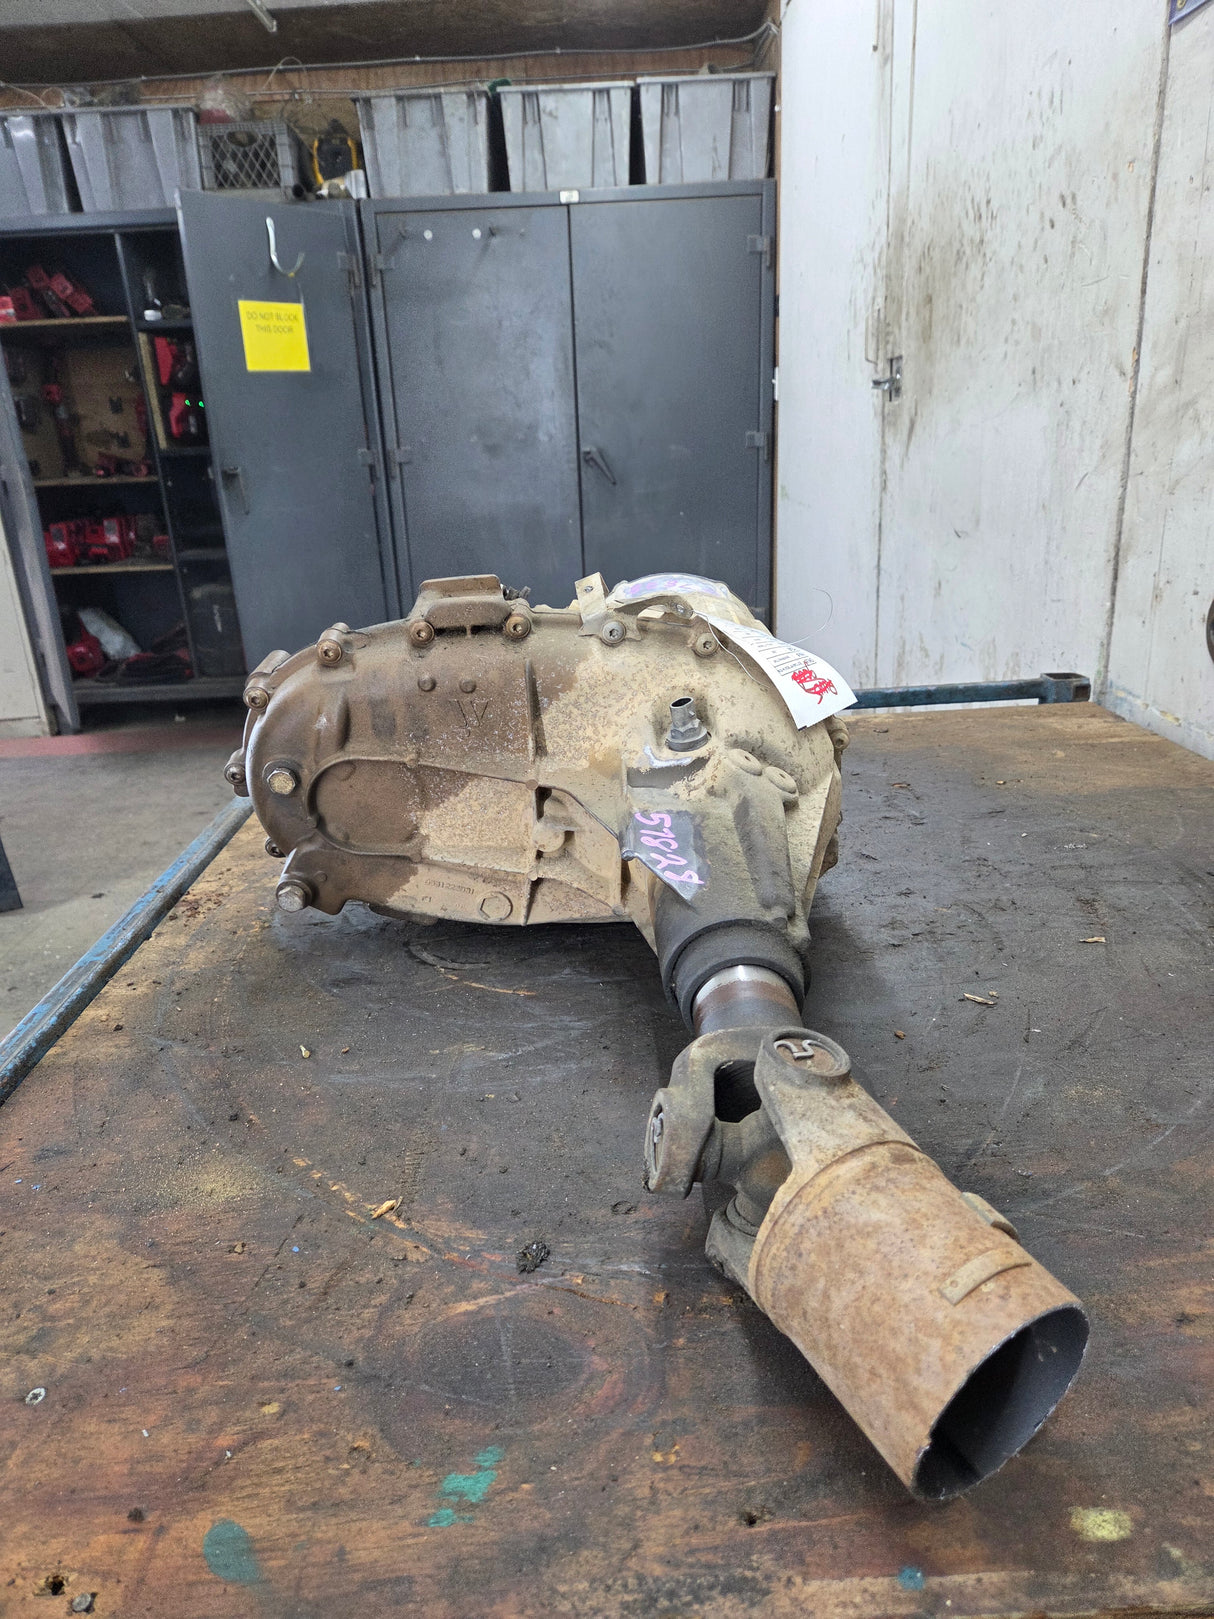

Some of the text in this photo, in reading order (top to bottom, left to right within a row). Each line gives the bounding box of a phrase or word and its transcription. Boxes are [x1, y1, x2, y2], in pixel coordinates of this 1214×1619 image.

[246, 311, 299, 323] DO NOT BLOCK
